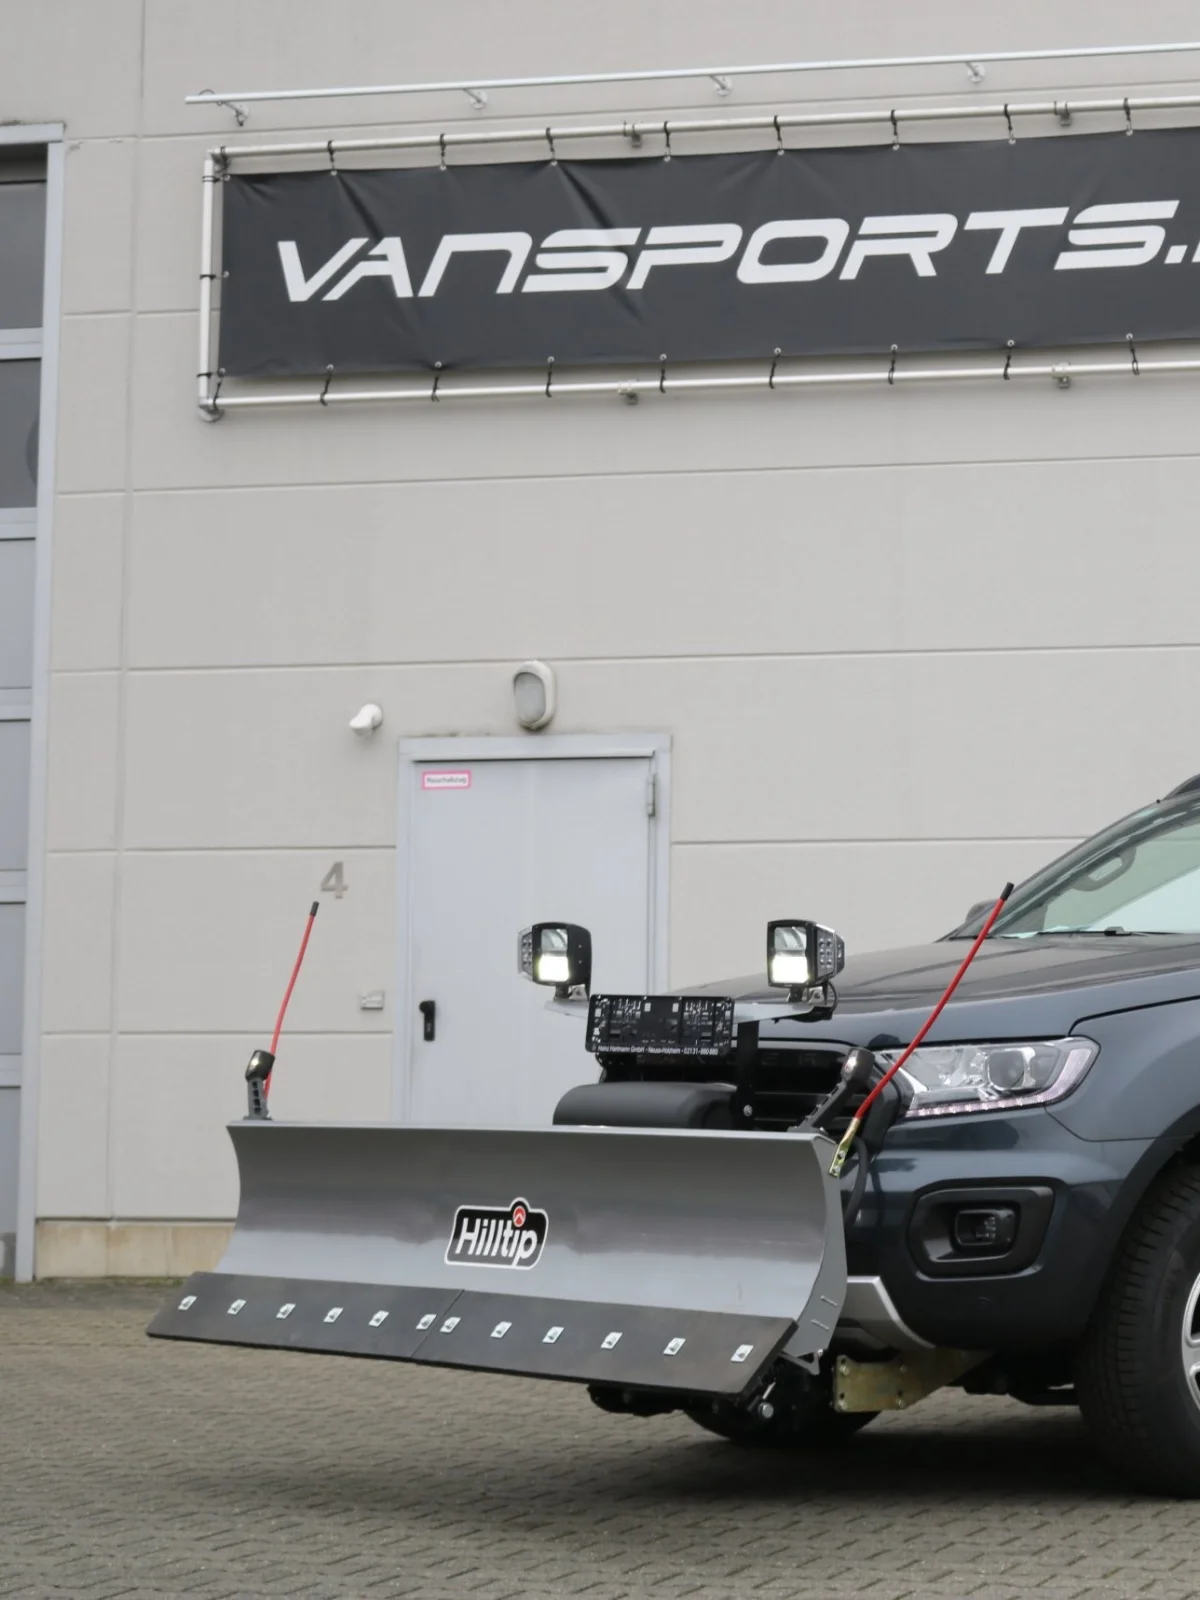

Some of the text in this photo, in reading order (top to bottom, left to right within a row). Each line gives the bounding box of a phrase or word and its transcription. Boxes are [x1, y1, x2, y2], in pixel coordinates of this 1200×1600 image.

[320, 861, 349, 900] 4
[631, 1045, 645, 1053] GmbH
[455, 1217, 539, 1267] Hilltip
